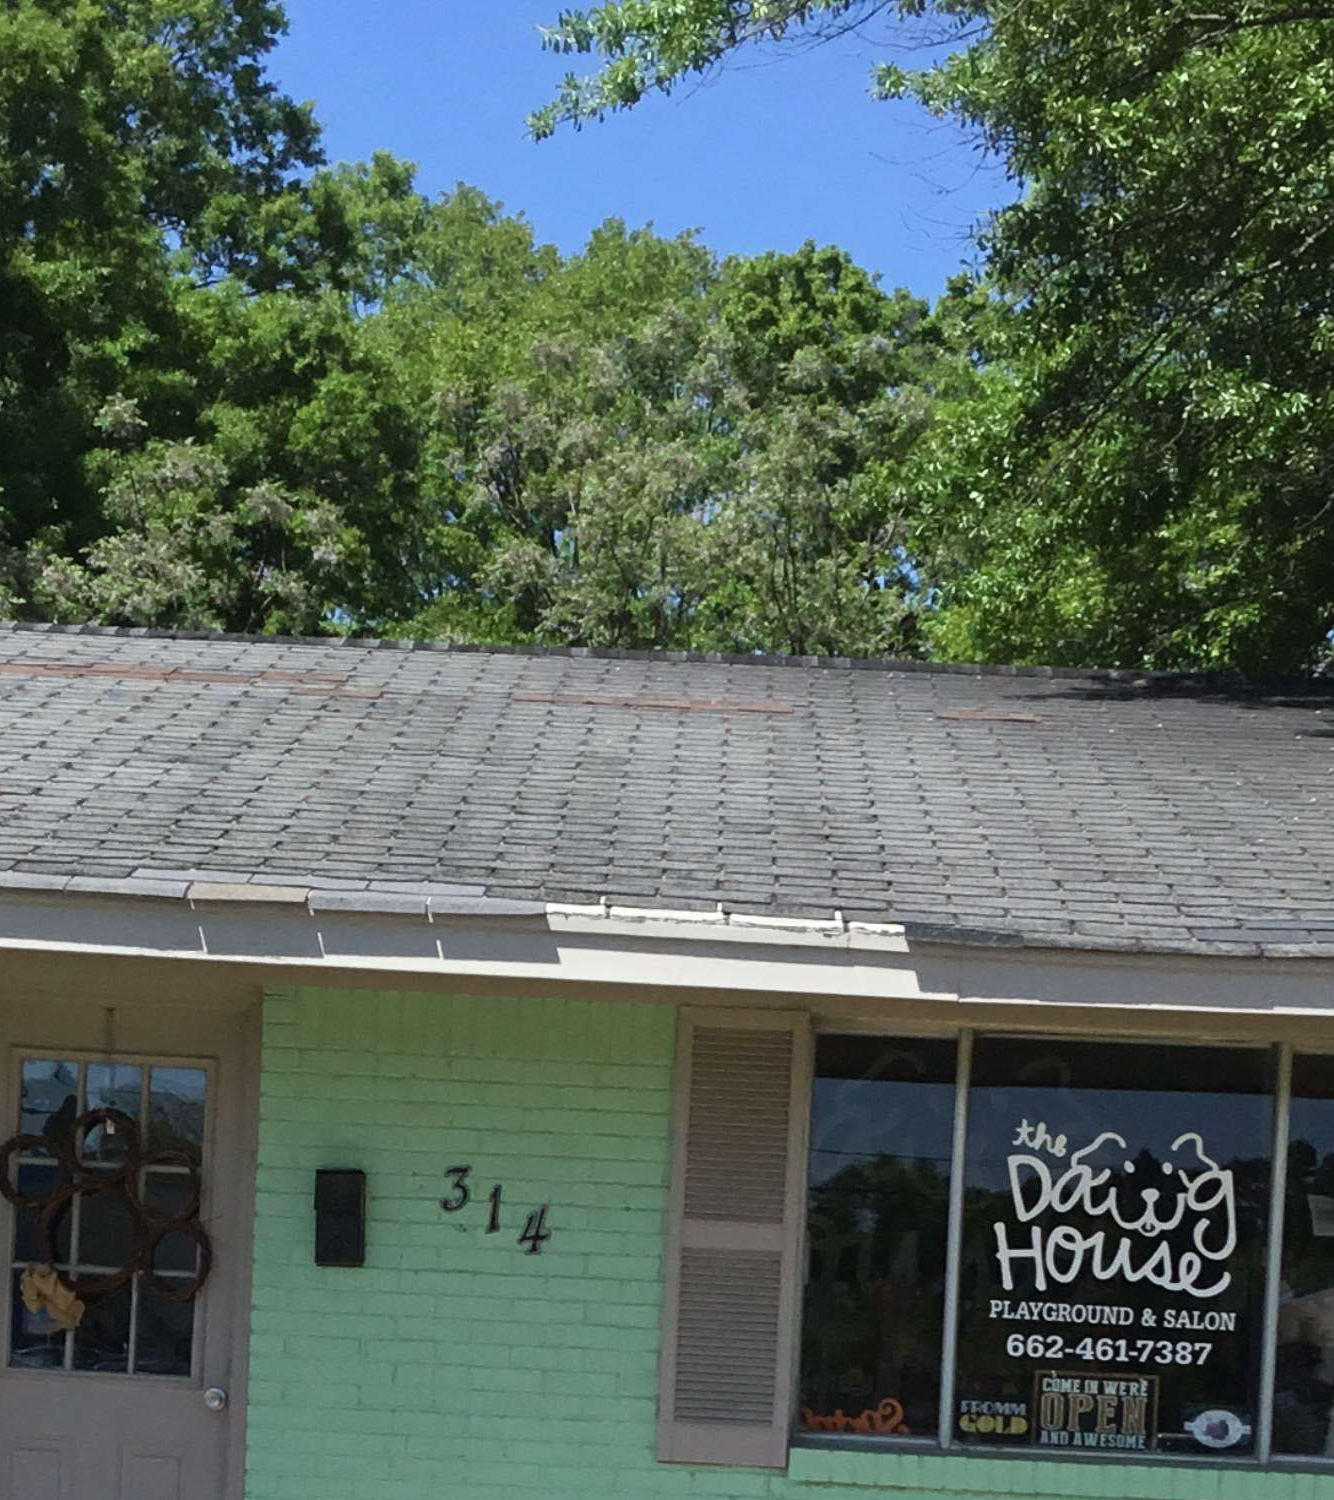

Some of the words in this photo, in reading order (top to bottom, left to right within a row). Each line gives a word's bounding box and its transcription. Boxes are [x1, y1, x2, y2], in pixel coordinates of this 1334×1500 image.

[1012, 1118, 1068, 1157] the
[441, 1165, 553, 1256] 314
[989, 1300, 1135, 1327] PLAYGROUND
[1140, 1308, 1157, 1328] &
[1163, 1309, 1237, 1332] SALON
[1006, 1334, 1213, 1366] 662-461-7387
[1042, 1377, 1081, 1393] COME
[1084, 1379, 1099, 1394] IN
[959, 1414, 1029, 1435] GOLD
[1040, 1392, 1148, 1435] OPEN
[1040, 1431, 1067, 1445] AND
[1073, 1432, 1147, 1449] AWESOME
